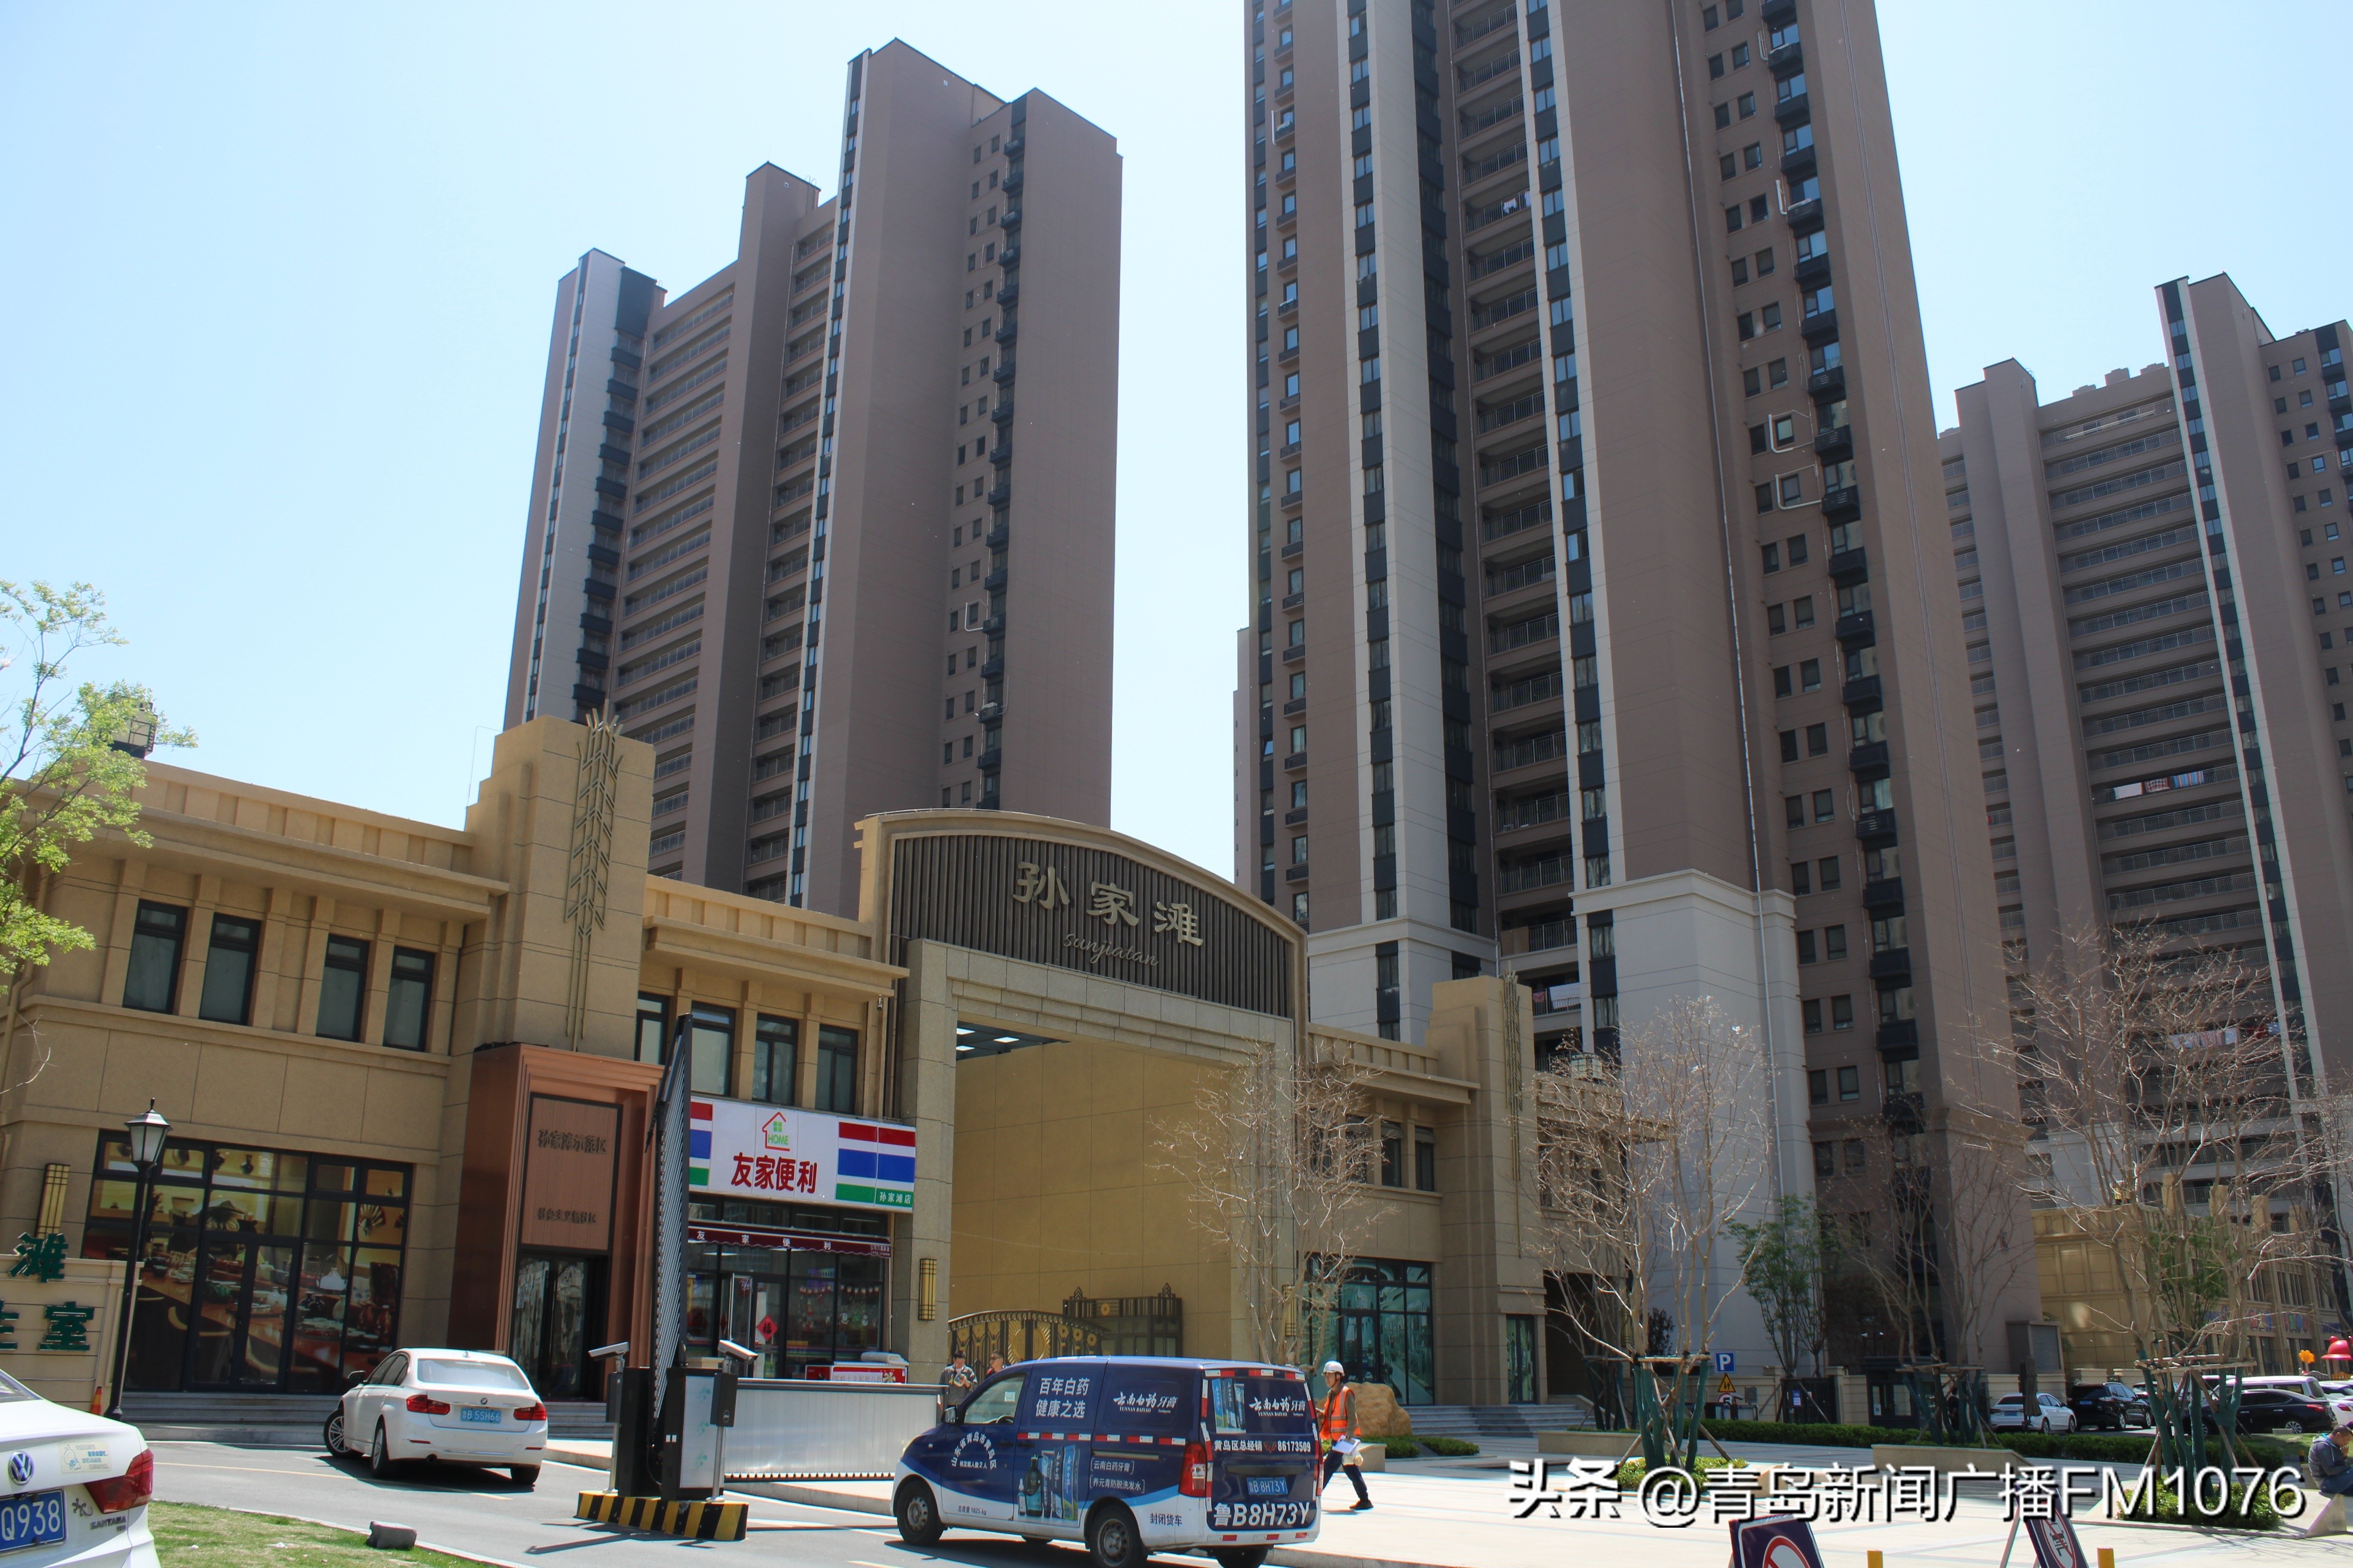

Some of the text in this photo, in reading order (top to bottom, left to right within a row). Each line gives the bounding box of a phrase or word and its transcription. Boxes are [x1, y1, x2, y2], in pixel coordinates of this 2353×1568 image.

[1013, 861, 1204, 946] 孙家滩
[1063, 933, 1159, 966] sunjiatan
[768, 1134, 789, 1145] HOME
[731, 1152, 817, 1194] 友家便利
[879, 1191, 912, 1204] 孙家滩店
[697, 1230, 831, 1250] 友家便利
[8, 1232, 69, 1283] 滩
[1719, 1354, 1731, 1370] P
[1039, 1377, 1090, 1395] 百年白药
[1035, 1399, 1086, 1418] 健康之选
[1113, 1391, 1179, 1409] 云南白药牙膏
[1249, 1396, 1306, 1412] 云南白药牙膏
[951, 1431, 997, 1470] 山东省青岛市黄岛区
[1214, 1439, 1311, 1452] 黄岛区总经销 86173509
[1094, 1460, 1131, 1471] 云南白药牙膏
[1093, 1477, 1142, 1491] 养元青防脱洗发水
[1, 1499, 61, 1541] Q938
[1150, 1513, 1183, 1526] 封闭货车
[1214, 1502, 1310, 1526] 鲁B8H73Y
